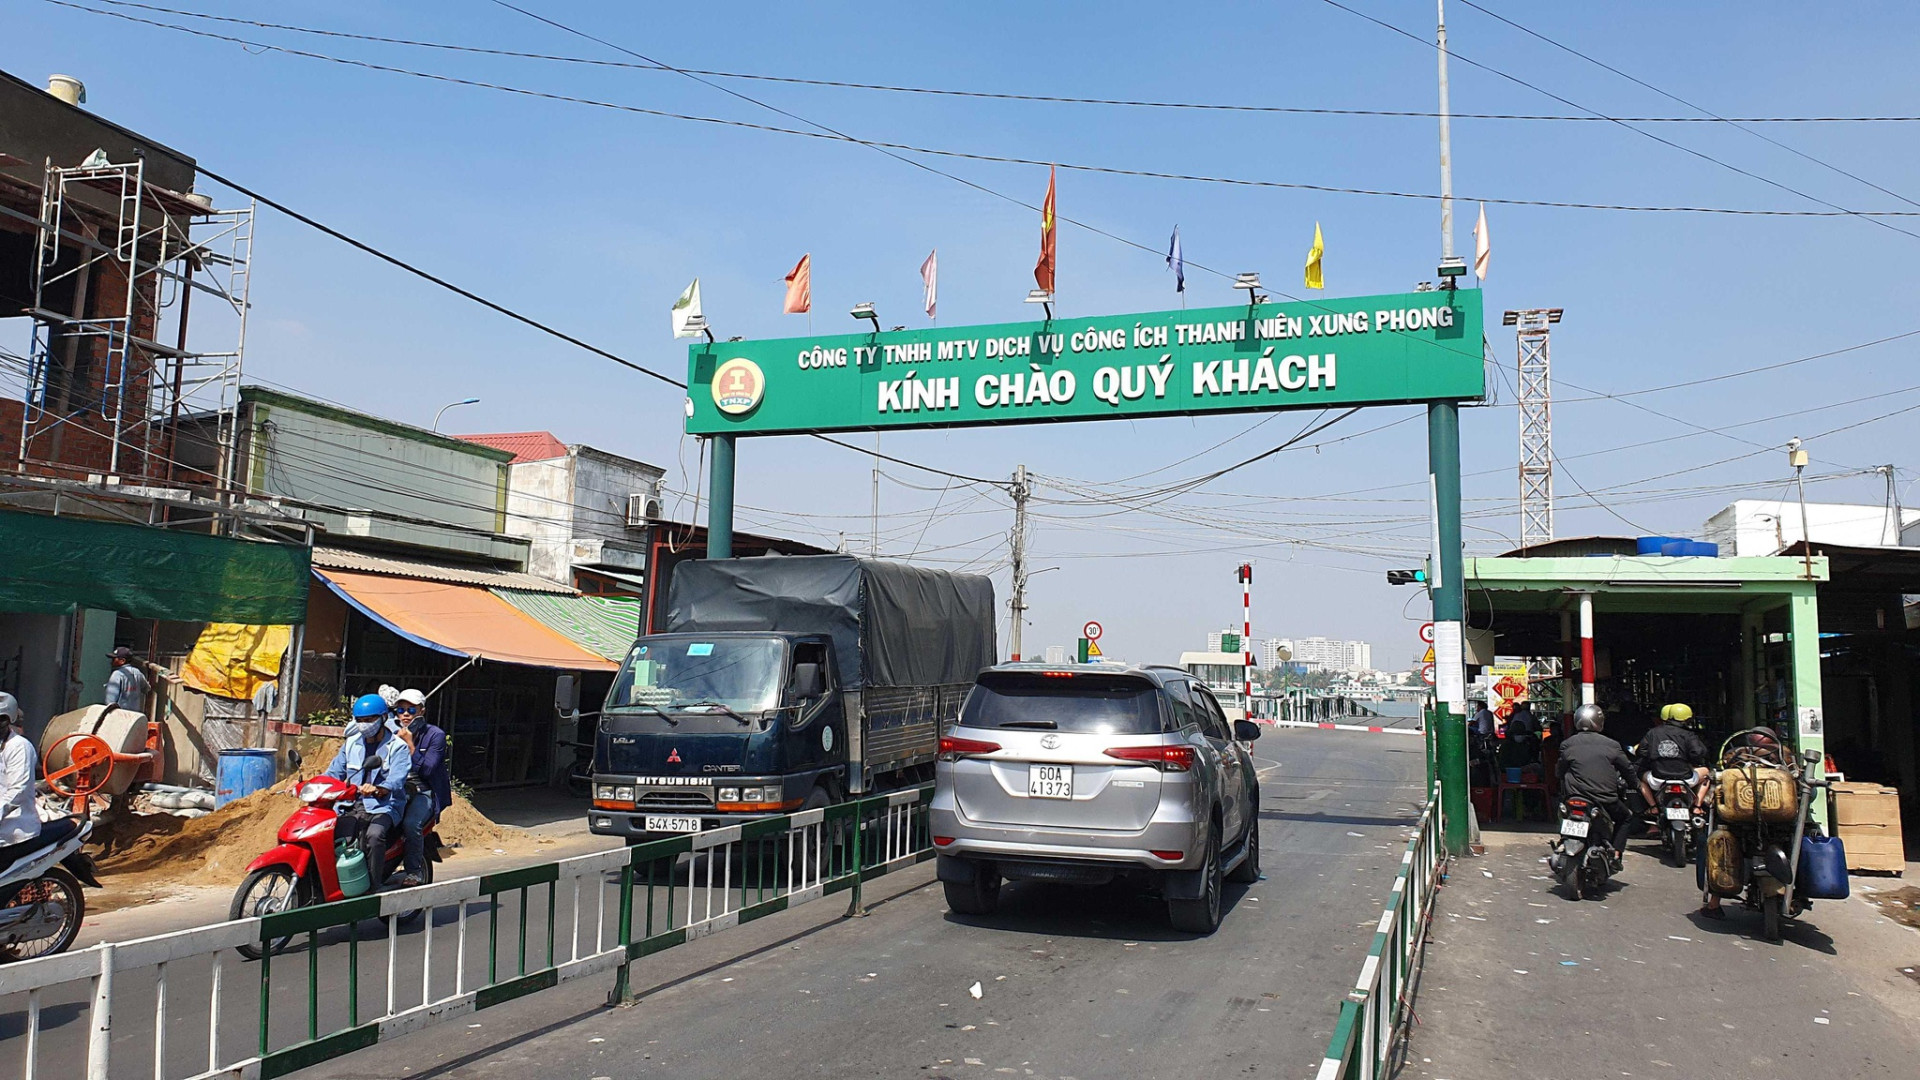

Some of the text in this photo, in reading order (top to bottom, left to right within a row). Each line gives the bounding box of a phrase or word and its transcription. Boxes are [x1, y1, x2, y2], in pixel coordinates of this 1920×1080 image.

[797, 306, 1453, 370] CÔNG TY TNHH MTV DỊCH VỤ CÔNG ÍCH THANH NIÊN XUNG PHONG
[877, 345, 1337, 413] KÍNH CHÀO QUÝ KHÁCH
[703, 764, 745, 772] CANTER
[1039, 766, 1062, 781] 60A
[636, 776, 712, 786] MITSUBISHI
[1030, 781, 1071, 796] 413.73
[648, 817, 698, 831] 54X-5718
